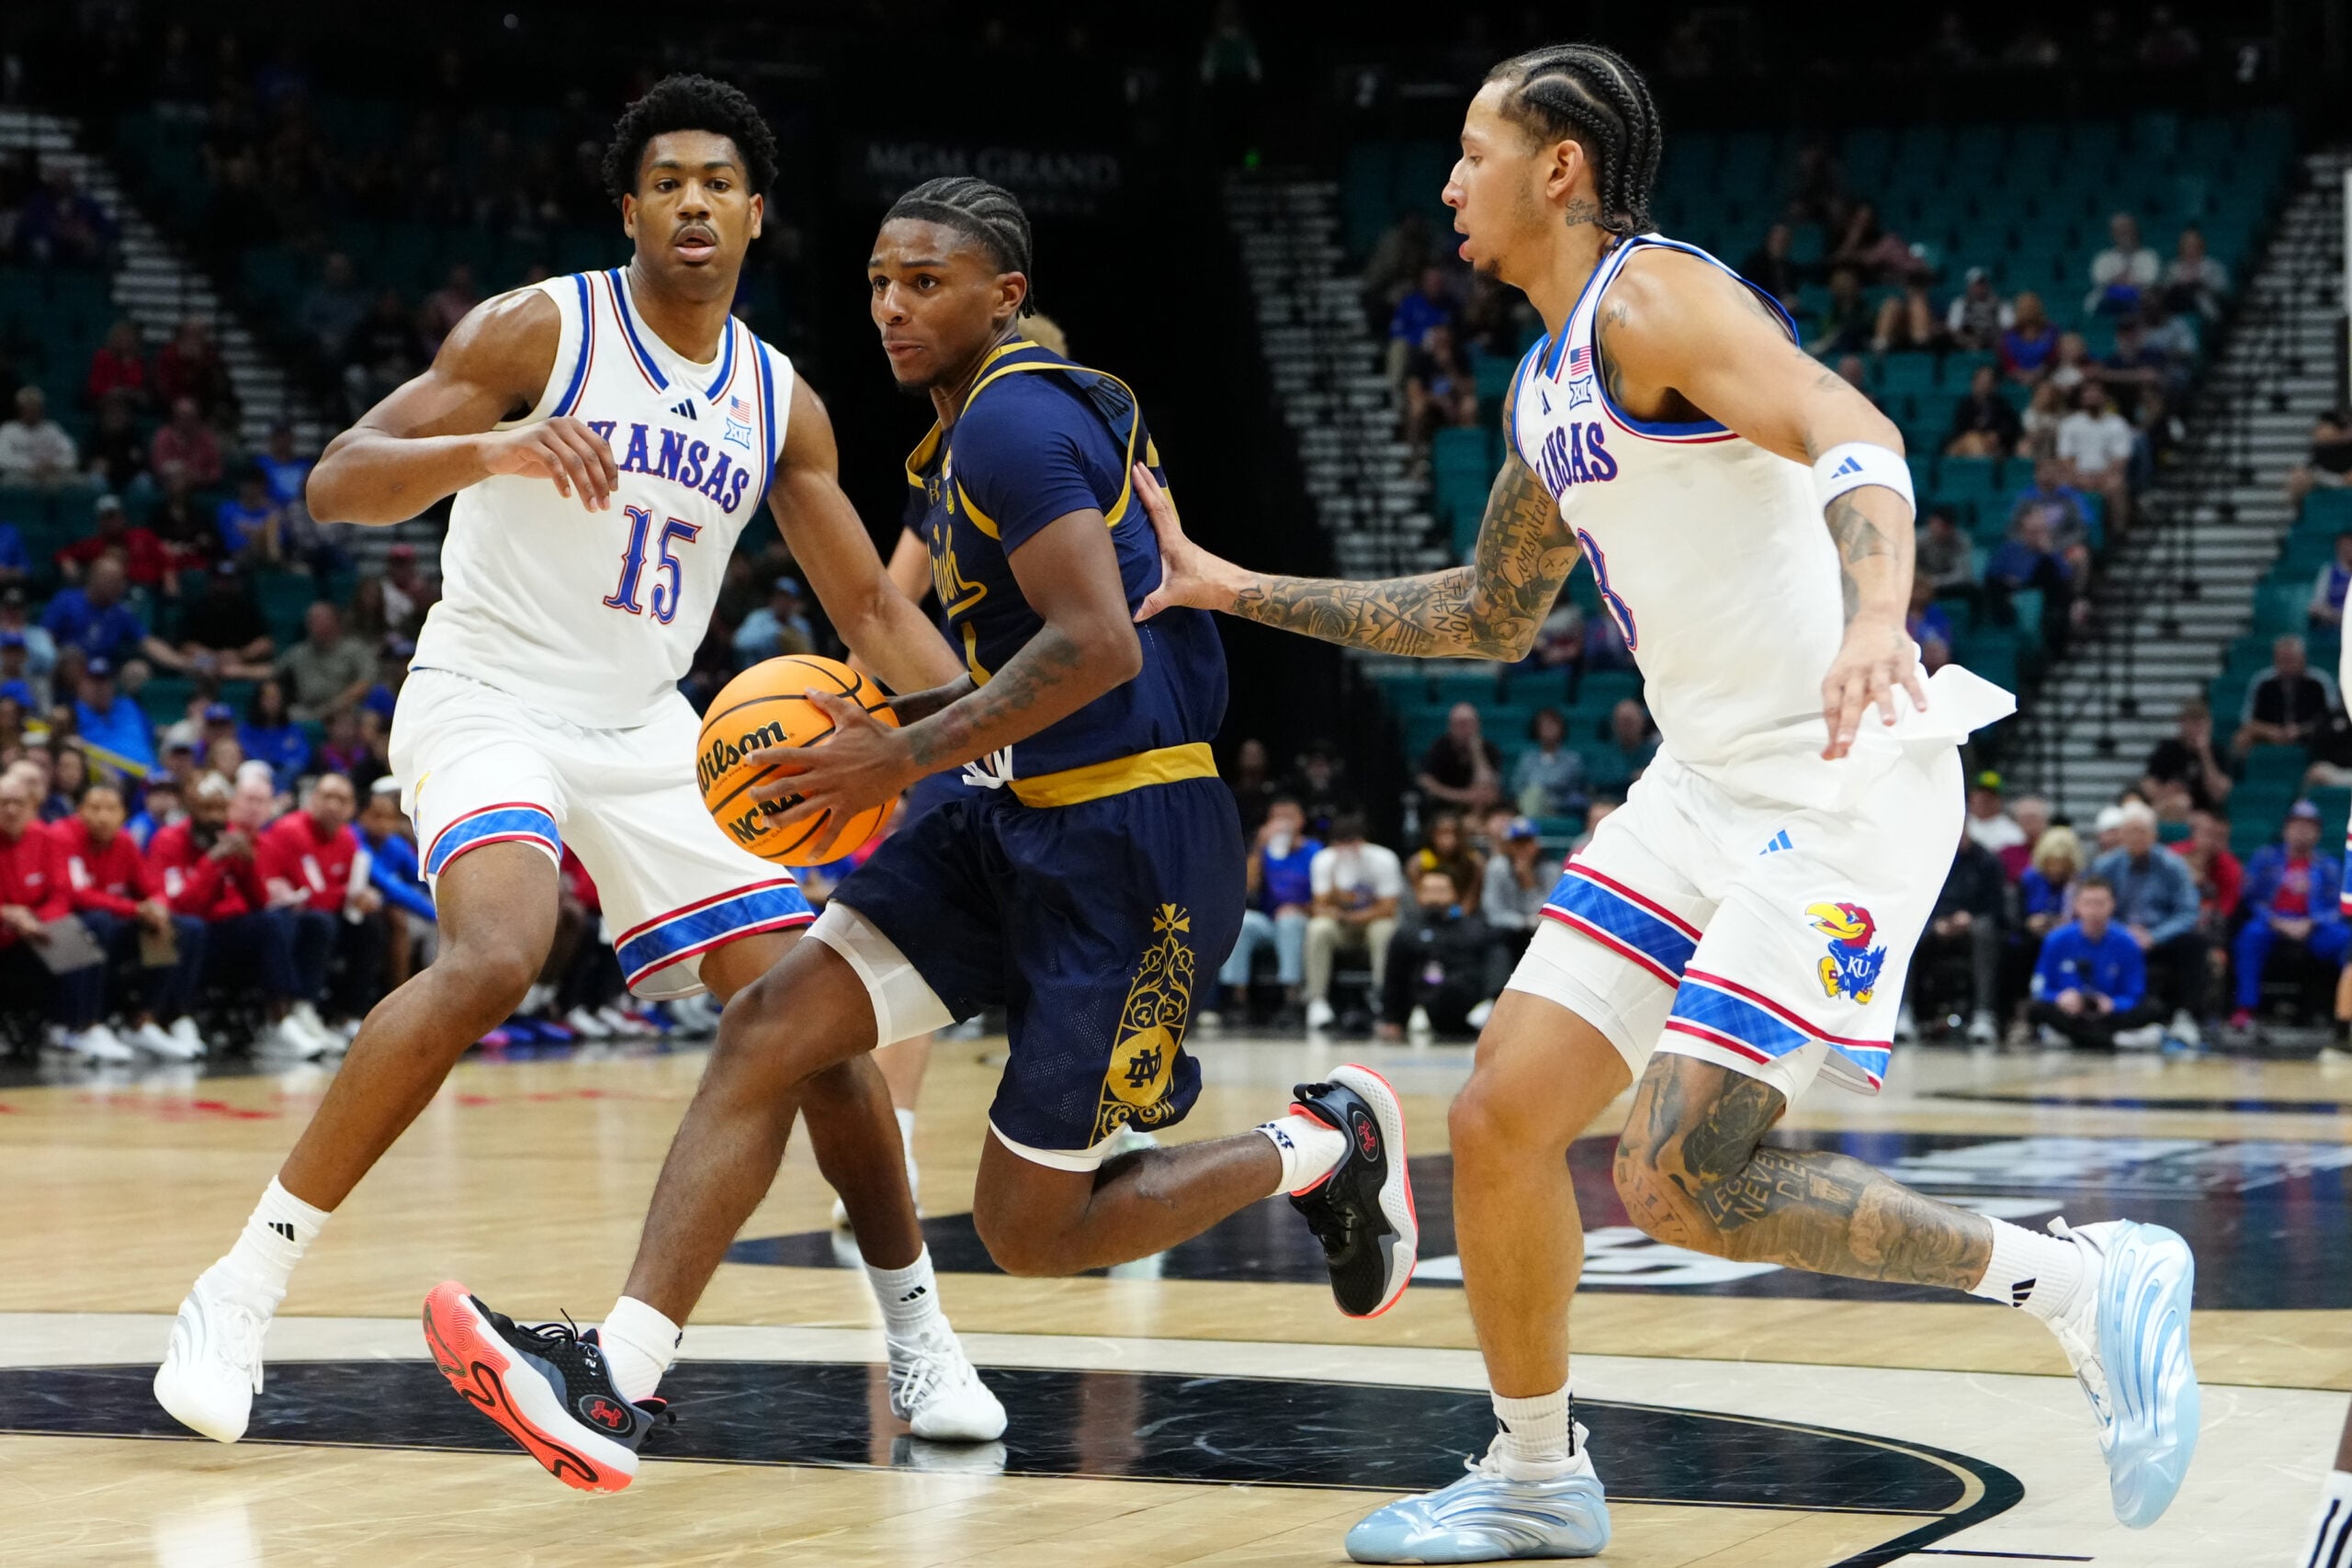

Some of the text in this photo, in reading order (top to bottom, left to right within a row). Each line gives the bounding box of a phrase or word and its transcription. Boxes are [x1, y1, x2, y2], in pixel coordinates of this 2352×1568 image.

[975, 145, 1120, 191] GRAND
[1536, 422, 1618, 504] ANSAS
[603, 504, 702, 625] 15
[697, 720, 788, 798] Wilson
[1846, 955, 1871, 978] KU
